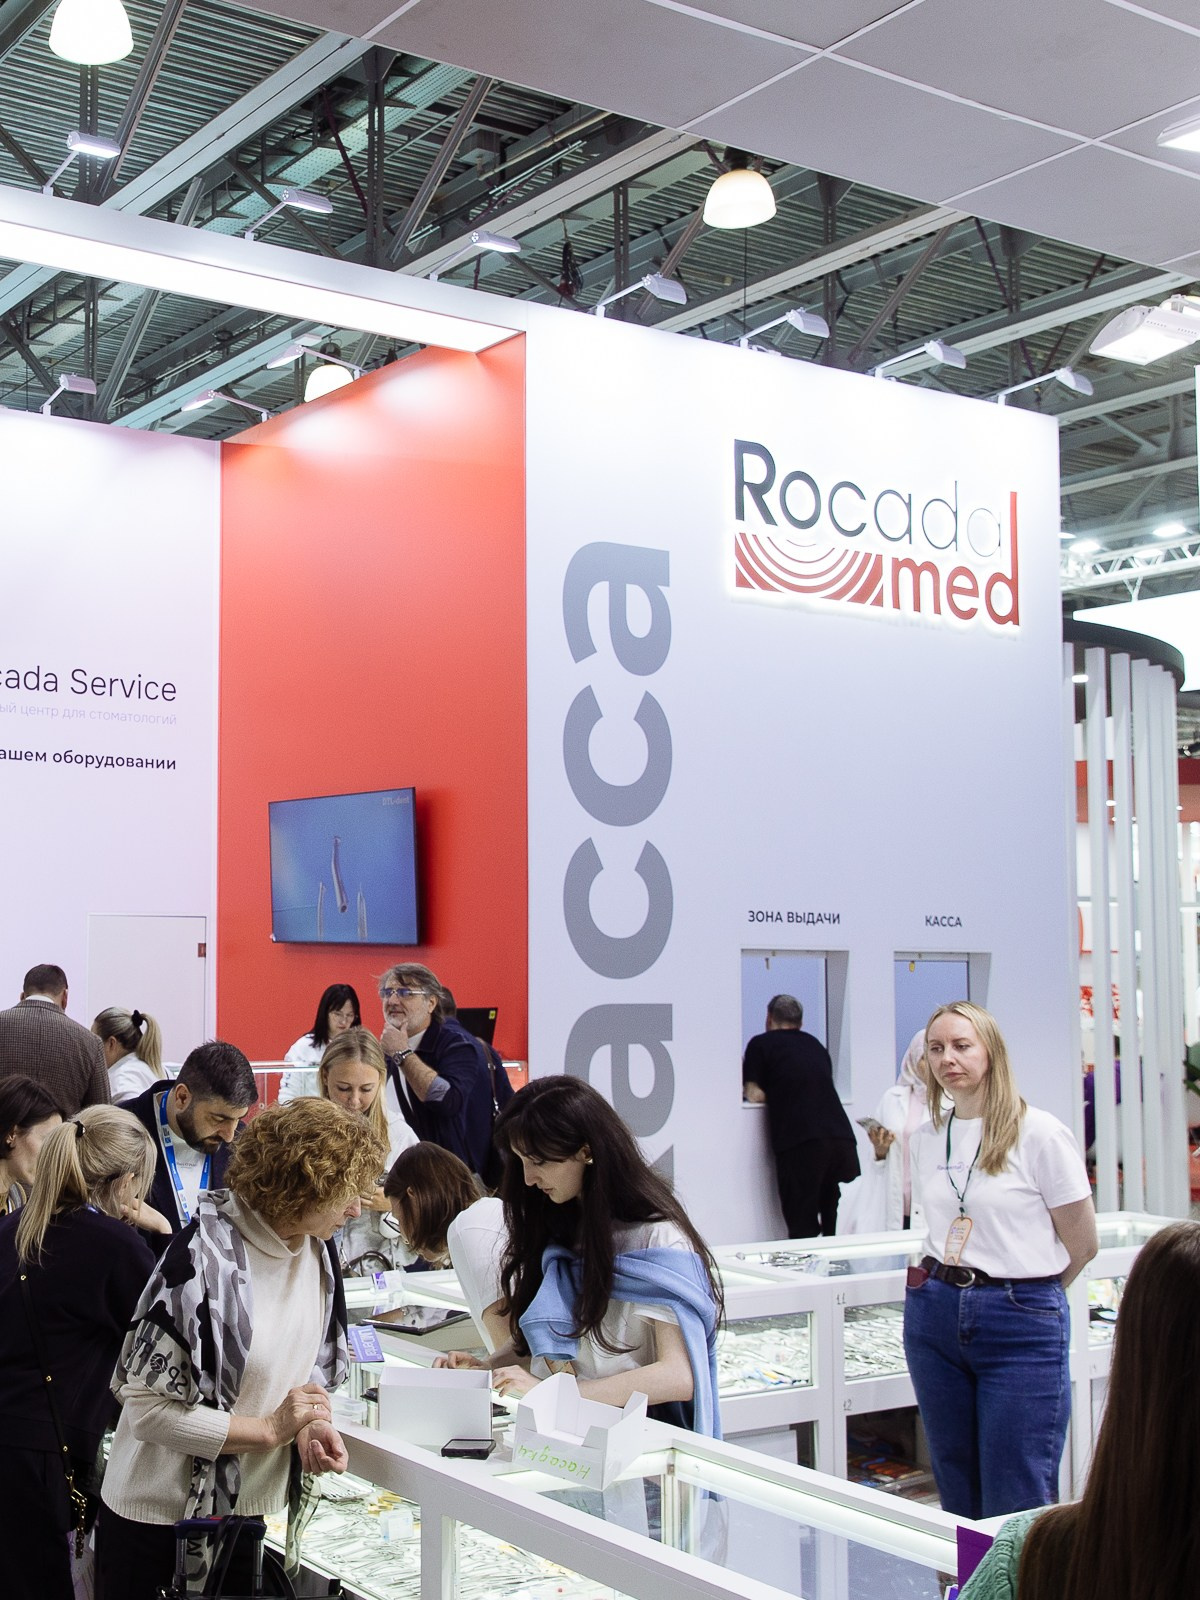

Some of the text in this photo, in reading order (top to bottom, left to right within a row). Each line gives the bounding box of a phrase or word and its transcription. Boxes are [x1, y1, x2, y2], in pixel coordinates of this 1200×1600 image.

[734, 439, 1001, 557] Rocada
[891, 491, 1020, 626] med
[70, 669, 177, 702] Service
[20, 704, 59, 719] центр
[62, 707, 86, 720] для
[52, 750, 176, 770] оборудовании
[562, 541, 675, 1190] асса
[748, 910, 841, 926] ЗОНА ВЫДАЧИ
[925, 915, 963, 928] КАССА
